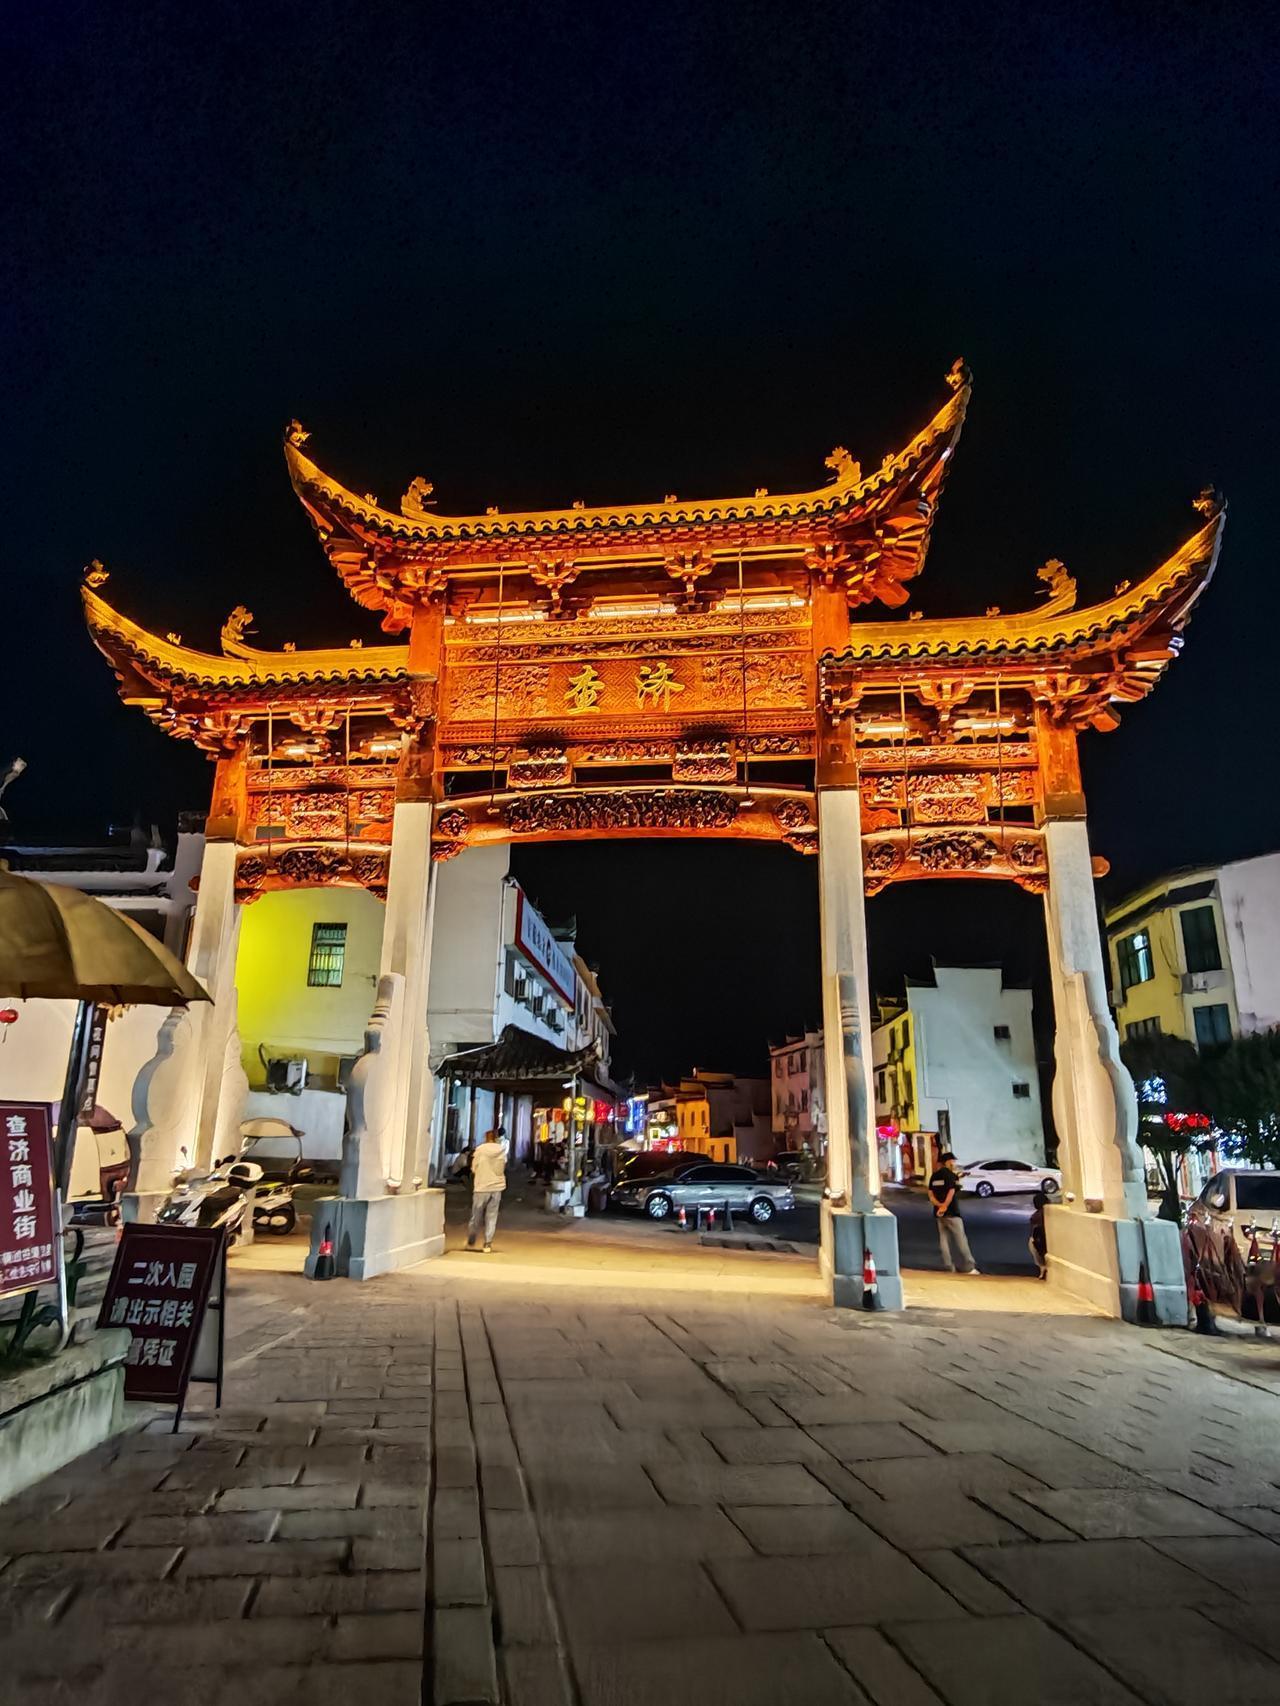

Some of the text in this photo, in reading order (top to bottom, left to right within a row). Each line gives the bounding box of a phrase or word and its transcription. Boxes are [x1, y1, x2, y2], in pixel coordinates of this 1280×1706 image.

[564, 662, 685, 714] 查济
[6, 1115, 37, 1240] 查济商业街
[128, 1261, 198, 1290] 二次入园
[109, 1296, 194, 1328] 请出示相关
